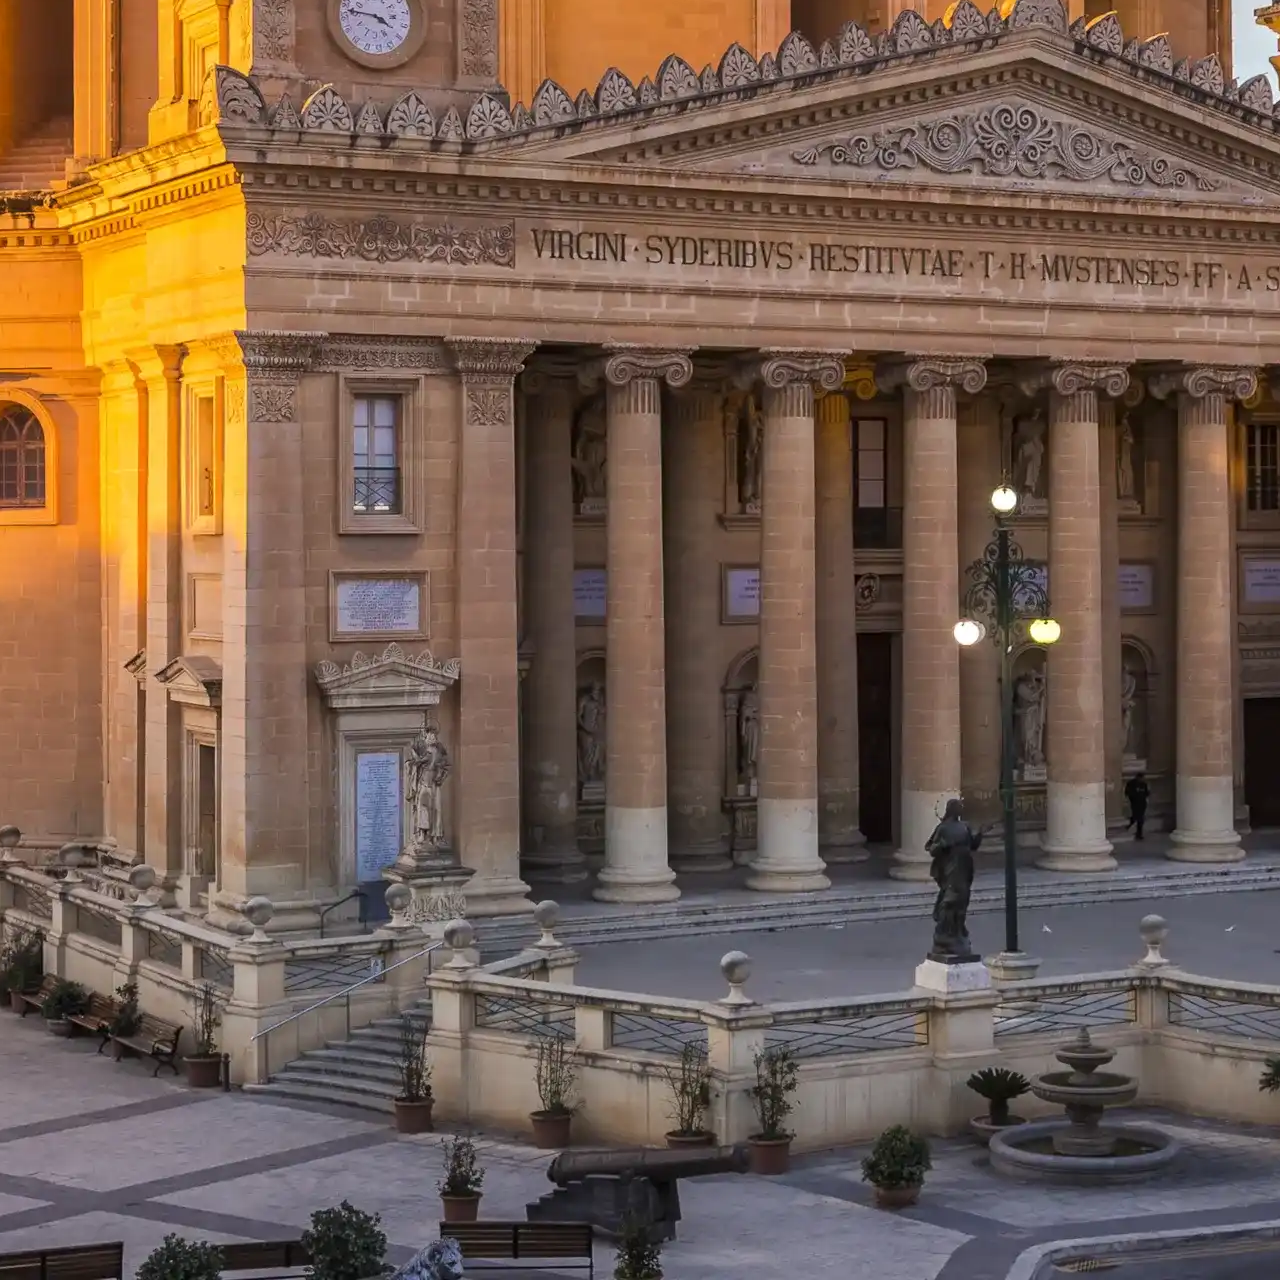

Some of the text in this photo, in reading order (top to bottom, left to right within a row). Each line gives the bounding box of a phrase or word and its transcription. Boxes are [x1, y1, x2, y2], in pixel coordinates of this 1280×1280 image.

[530, 228, 628, 262] VIRGINI
[645, 235, 794, 270] SYDERIBVS
[808, 242, 964, 278] RESTITVTAE
[978, 251, 995, 279] T
[1010, 252, 1028, 280] H
[1040, 254, 1180, 287] MVSTENSES
[1192, 262, 1223, 289] FF
[1237, 264, 1253, 291] A
[1266, 265, 1280, 292] S
